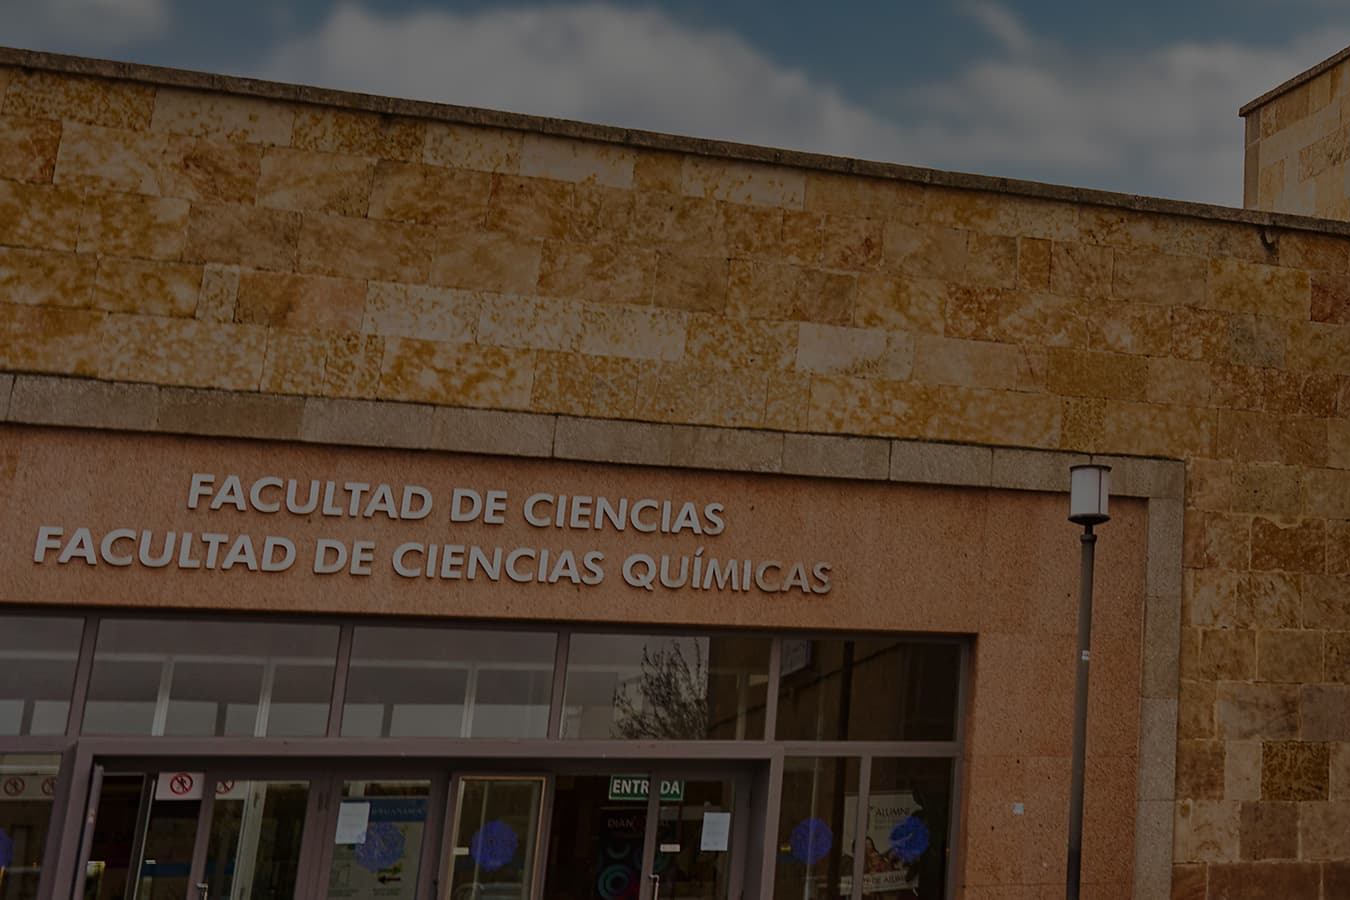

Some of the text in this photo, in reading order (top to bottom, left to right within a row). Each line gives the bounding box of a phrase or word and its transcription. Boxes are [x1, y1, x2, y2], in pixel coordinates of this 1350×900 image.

[187, 473, 725, 536] FACULTAD DE CIENCIAS
[33, 525, 832, 595] FACULTAD DE CIENCIAS QUÍMICAS
[612, 779, 681, 794] ENTRDA
